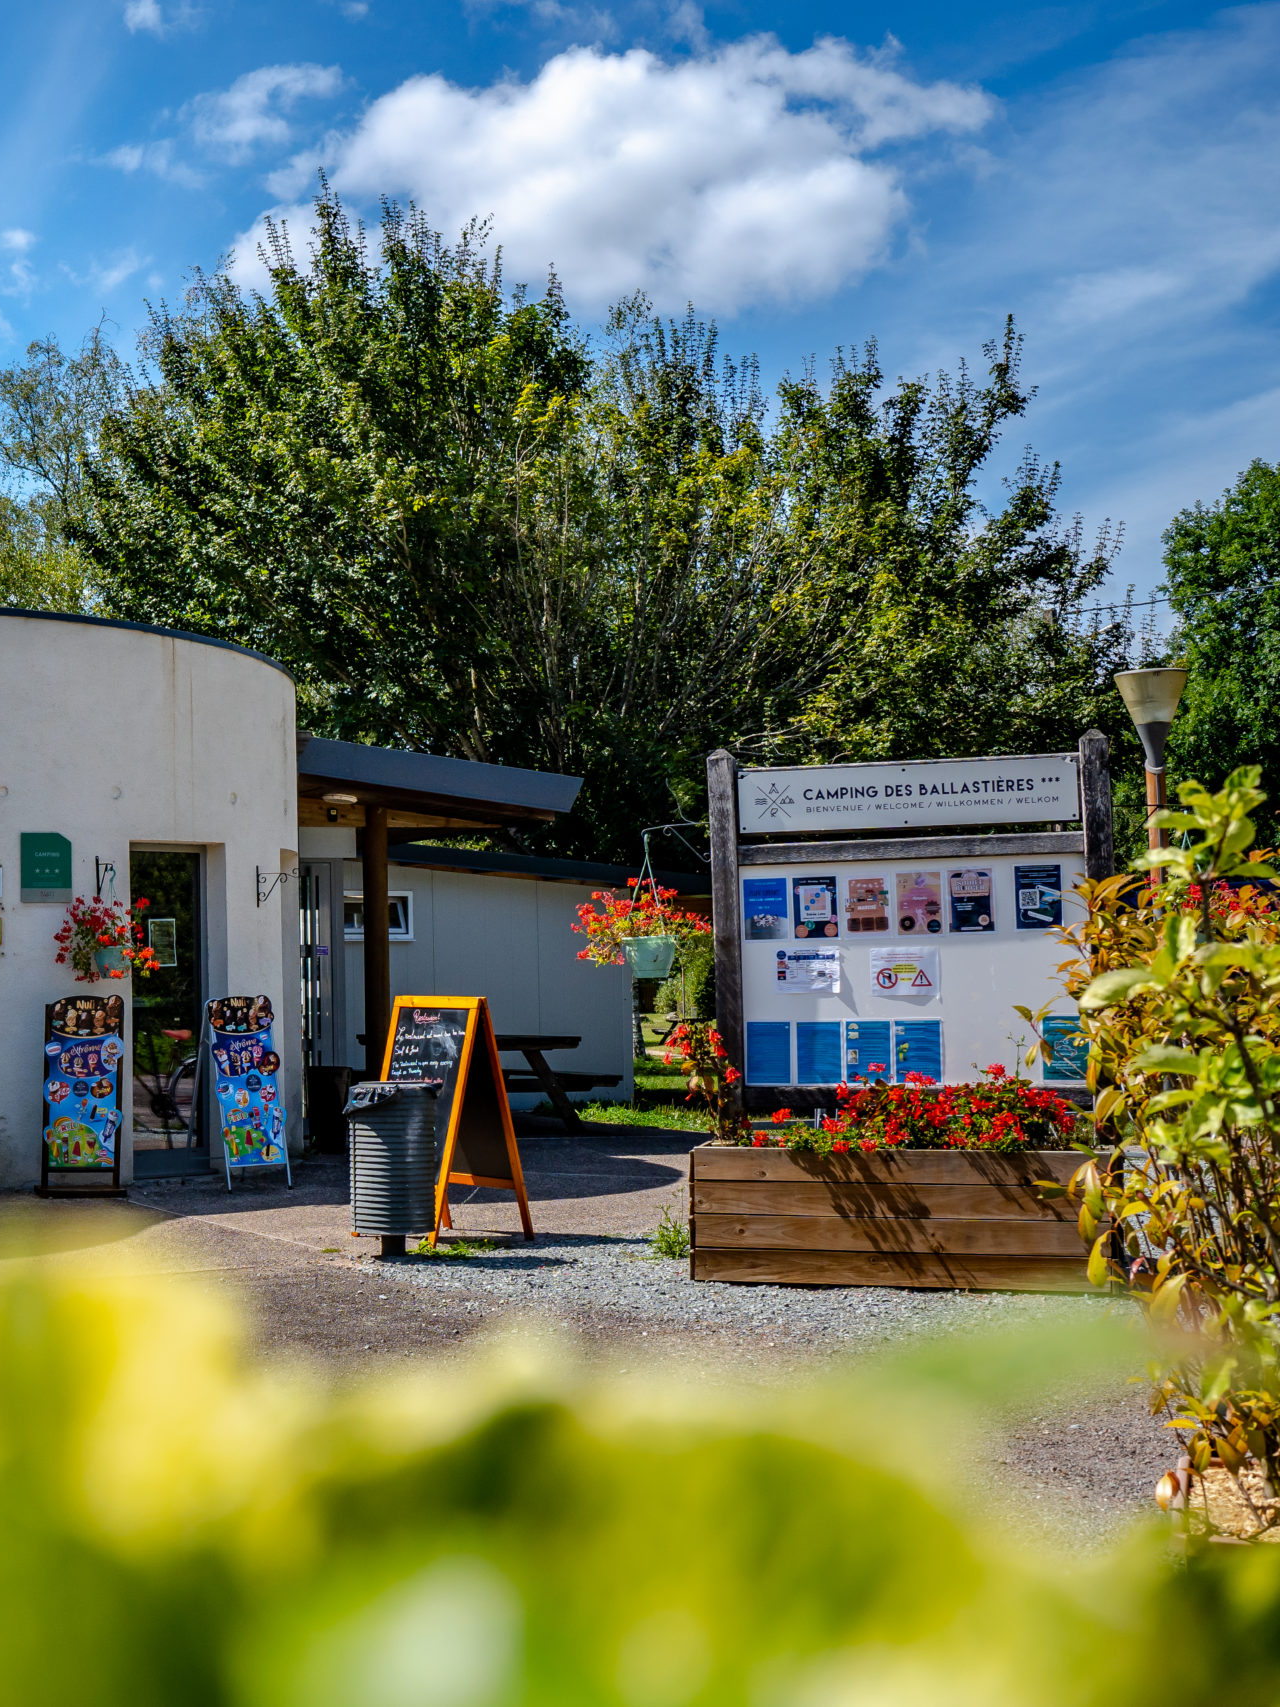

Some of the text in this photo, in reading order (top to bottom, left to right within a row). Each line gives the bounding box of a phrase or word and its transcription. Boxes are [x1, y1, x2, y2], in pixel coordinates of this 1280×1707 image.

[803, 785, 879, 801] CAMPING
[884, 784, 913, 797] DES
[919, 776, 1035, 796] BALLASTIÈRES
[805, 804, 864, 813] BIENVENUE
[874, 801, 925, 811] WELCOME
[935, 798, 1003, 808] WILLKOMMEN
[1015, 795, 1060, 805] WELKOM
